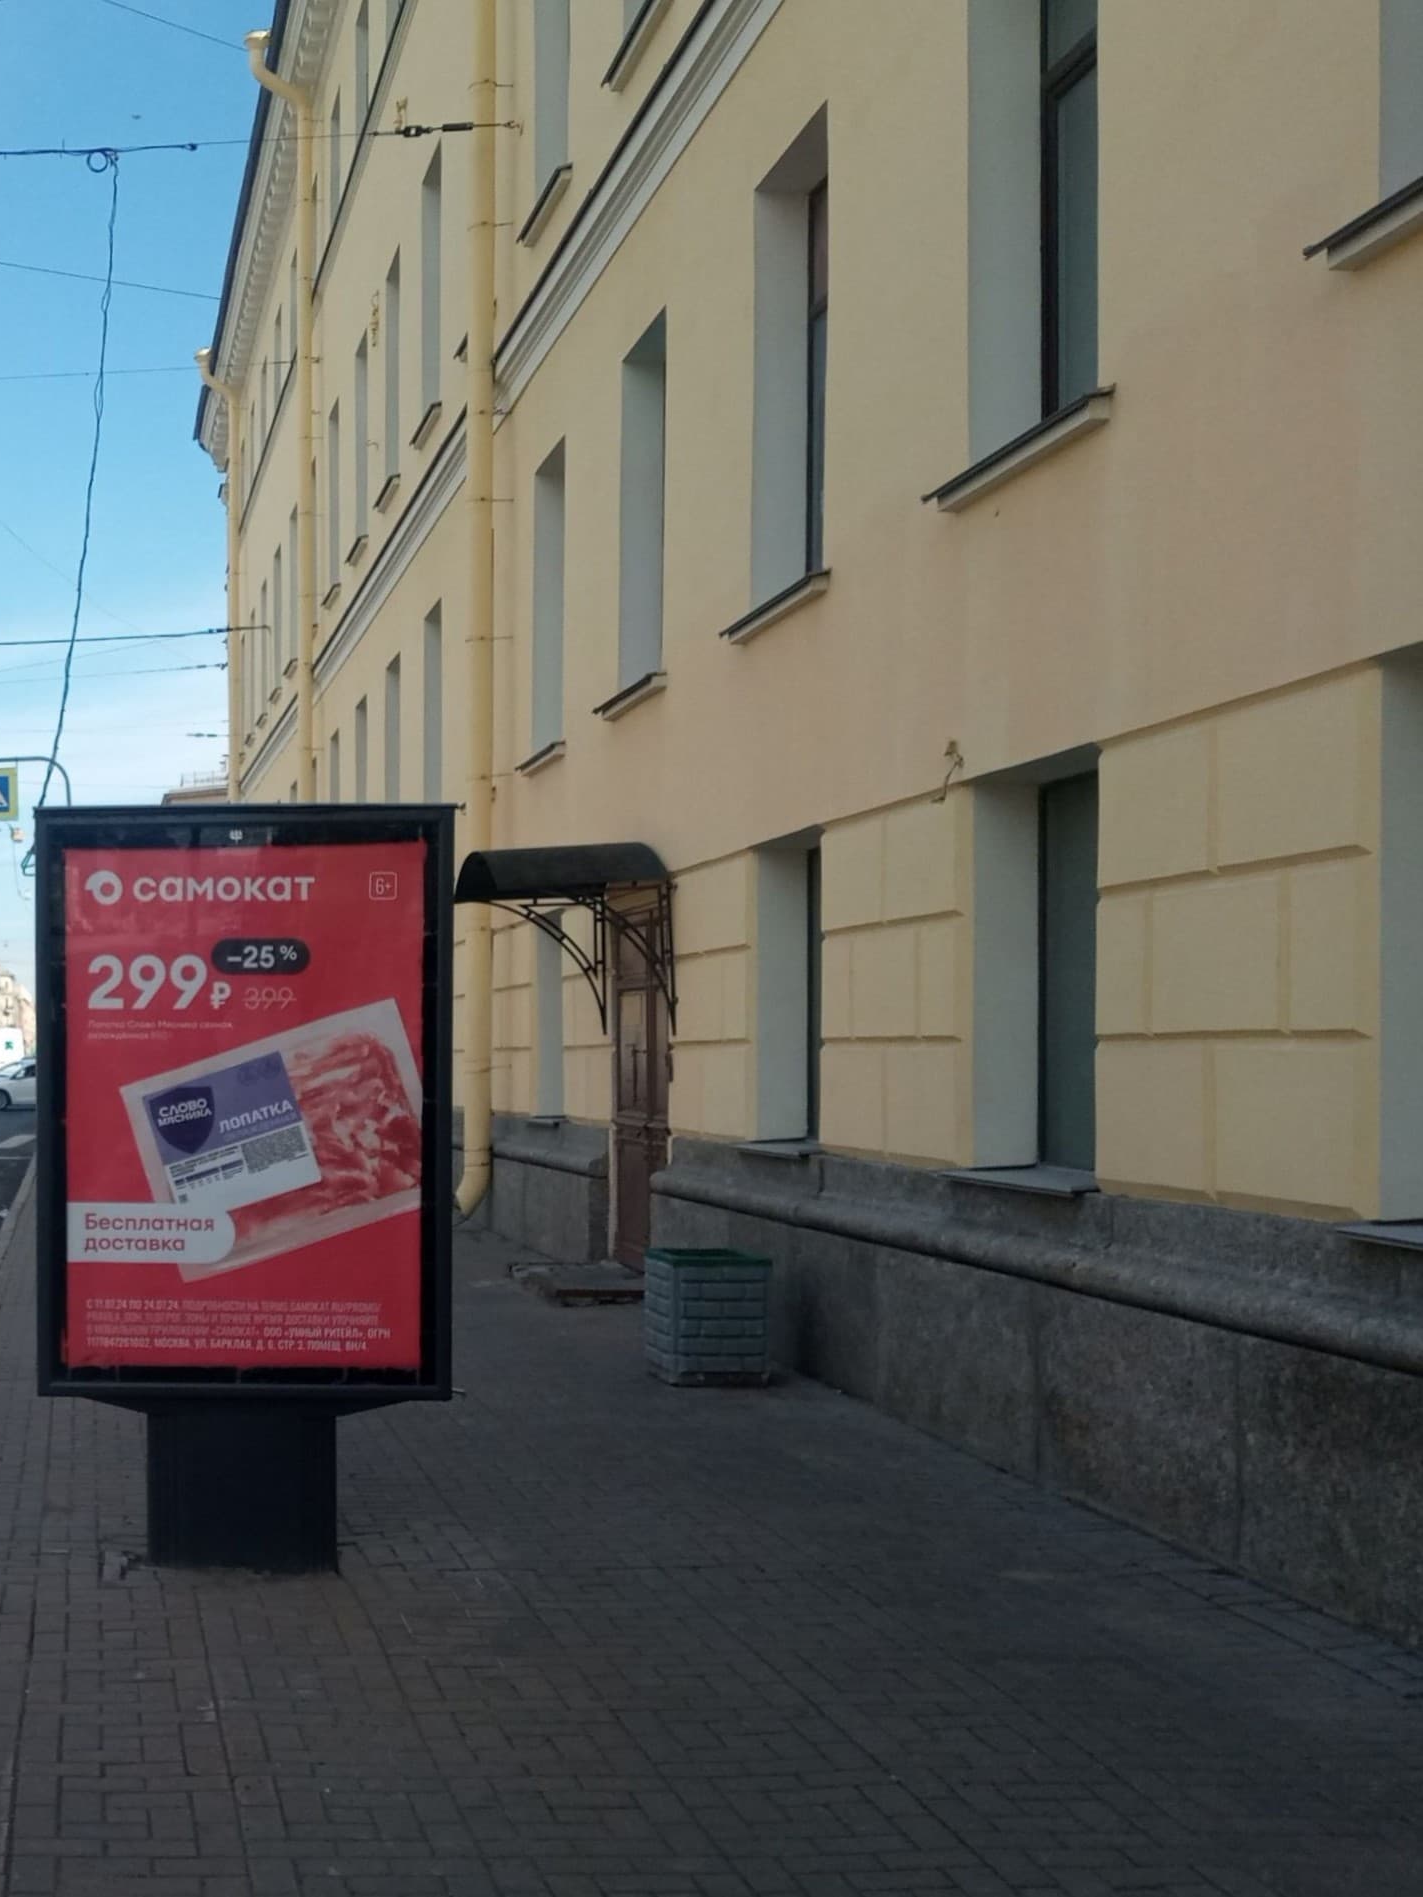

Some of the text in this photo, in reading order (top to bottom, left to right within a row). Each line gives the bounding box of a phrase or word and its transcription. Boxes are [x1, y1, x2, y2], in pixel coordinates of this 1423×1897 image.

[133, 876, 315, 902] самокат
[376, 878, 392, 895] 6+
[244, 987, 297, 1010] 399
[159, 1098, 208, 1118] СЛОВО
[219, 1099, 294, 1134] ЛОПАТКА
[84, 1213, 215, 1231] Бесплатная
[84, 1238, 186, 1253] доставка
